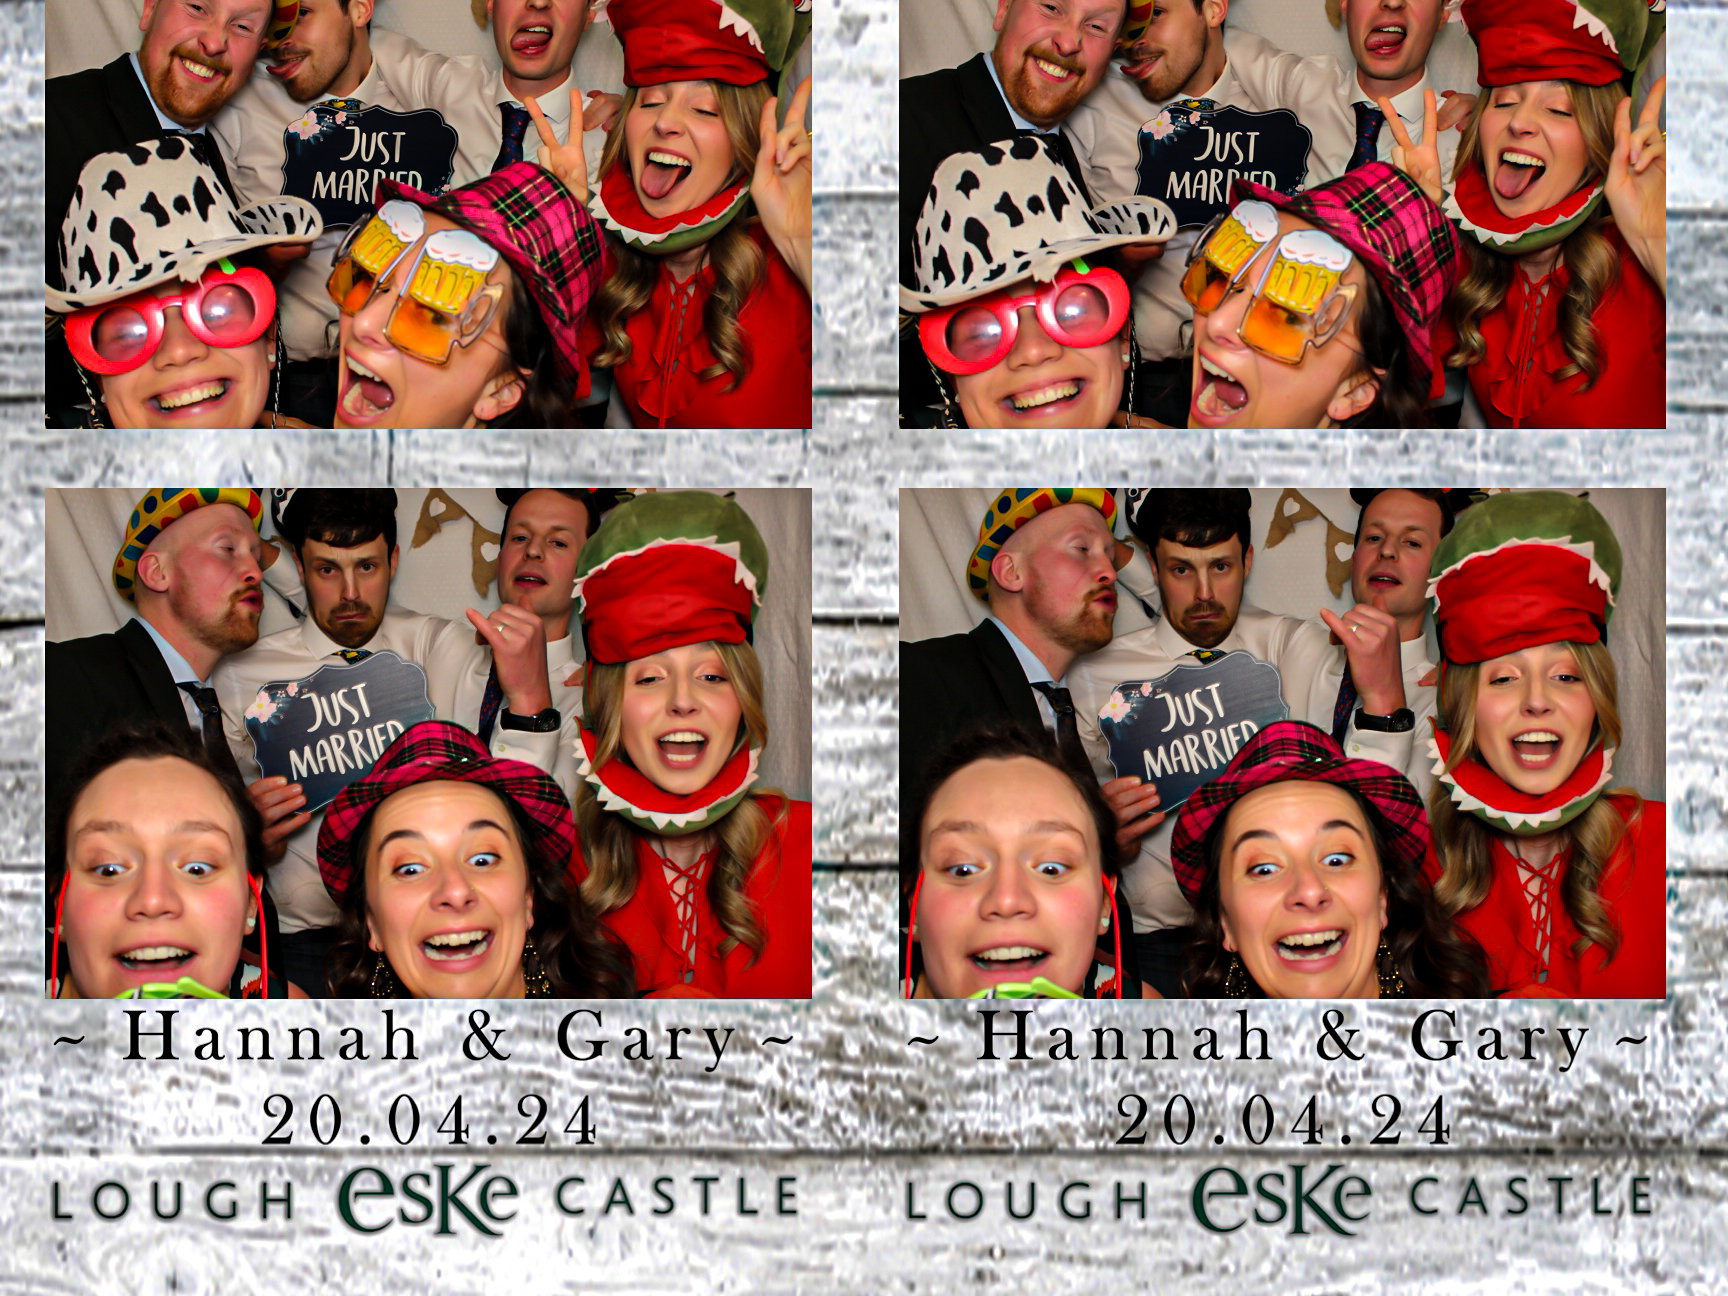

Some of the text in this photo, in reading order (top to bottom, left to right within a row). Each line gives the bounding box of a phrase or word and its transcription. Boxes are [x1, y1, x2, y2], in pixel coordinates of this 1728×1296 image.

[339, 125, 406, 165] JUST
[1193, 125, 1260, 165] JUST
[300, 683, 371, 733] JUST
[1154, 683, 1225, 733] JUST
